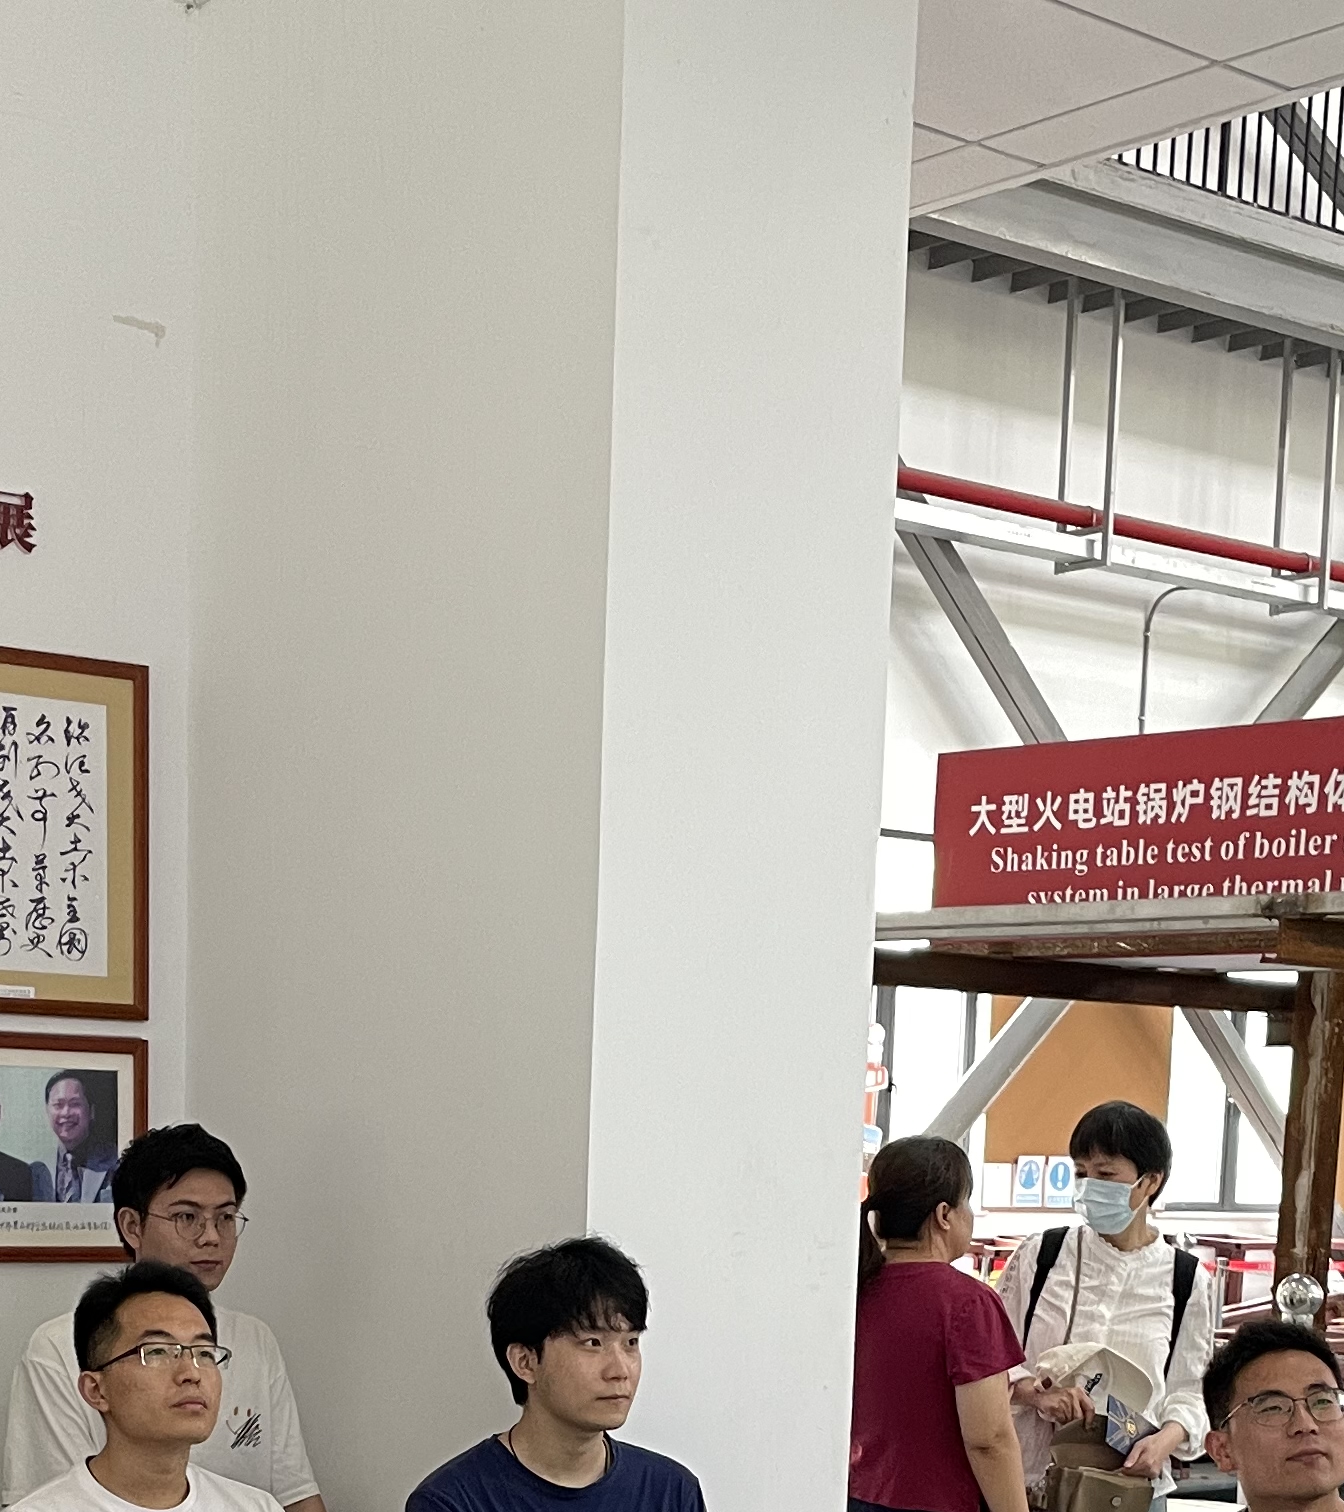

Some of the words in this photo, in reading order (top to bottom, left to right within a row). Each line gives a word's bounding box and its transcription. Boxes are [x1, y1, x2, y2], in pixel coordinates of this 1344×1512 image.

[990, 844, 1089, 875] Shaking
[1096, 839, 1158, 867] table
[1167, 835, 1213, 864] test
[1220, 831, 1249, 860] of
[1254, 828, 1338, 858] boiler
[1117, 880, 1139, 900] in
[1222, 870, 1332, 897] thermal
